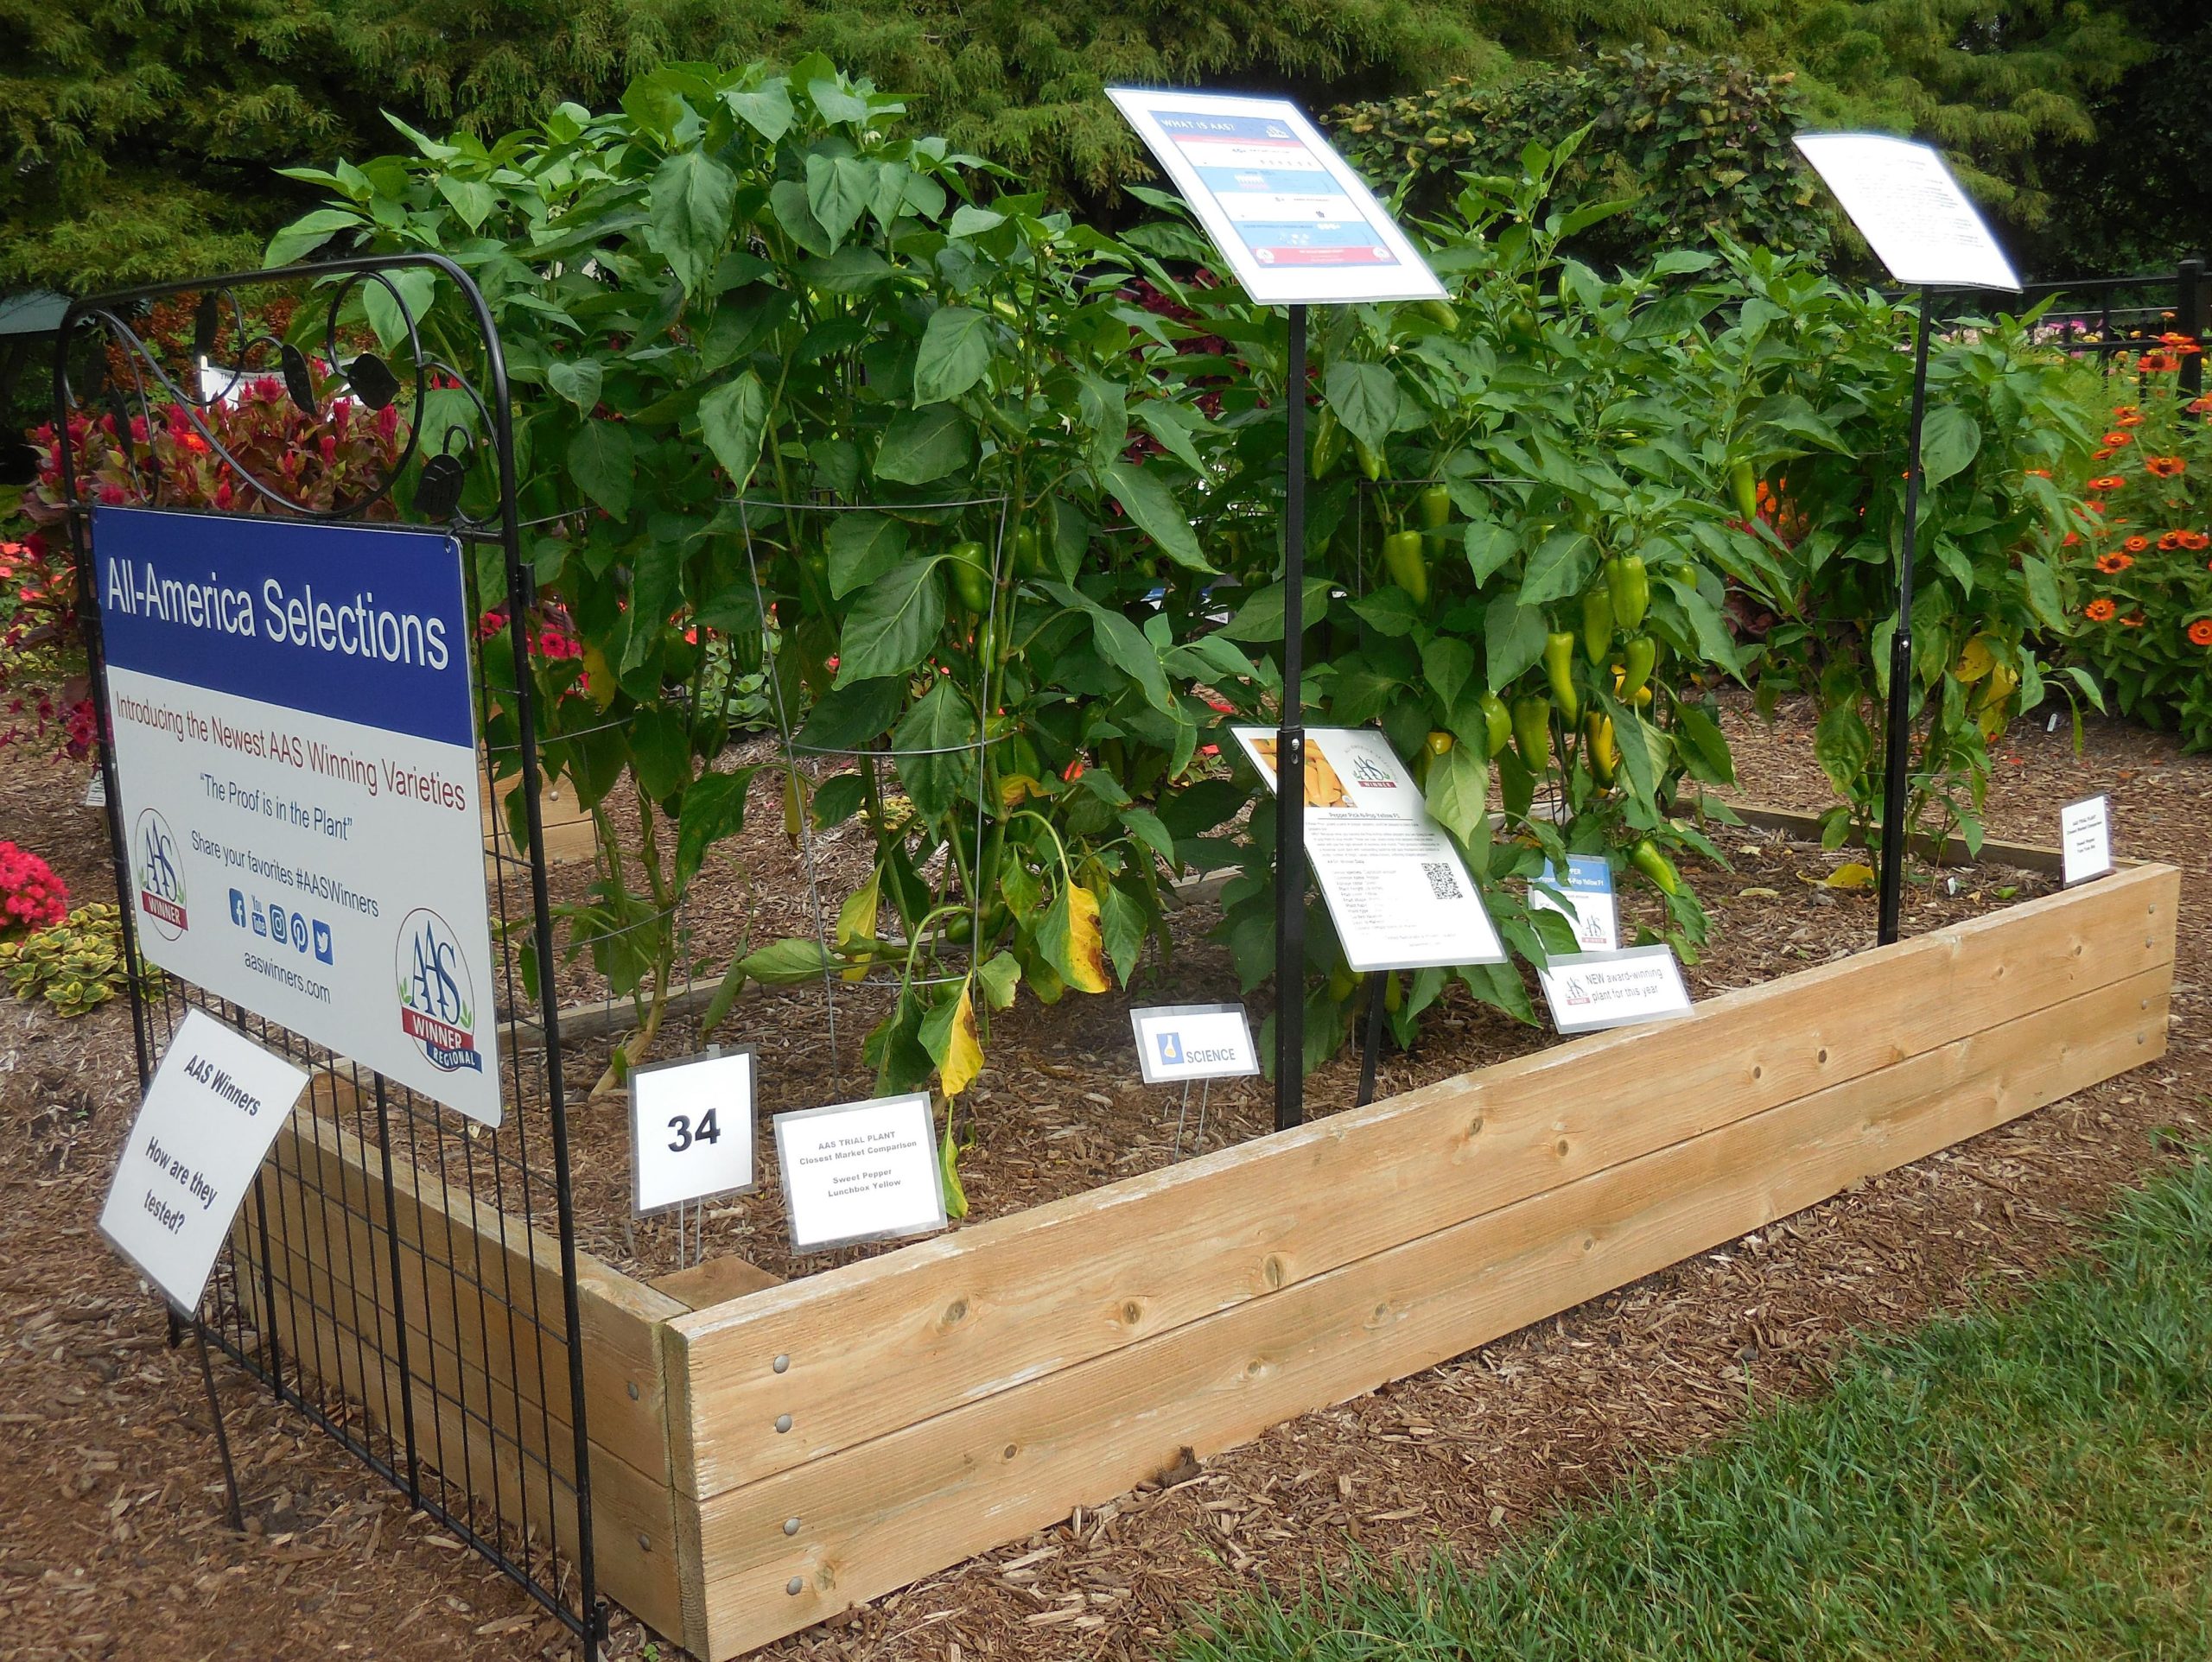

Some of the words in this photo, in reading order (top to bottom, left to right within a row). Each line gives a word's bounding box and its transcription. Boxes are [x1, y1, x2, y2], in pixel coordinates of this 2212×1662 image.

[1160, 119, 1194, 130] WHAT
[1211, 123, 1236, 131] AAS?
[108, 556, 257, 637] All-America
[264, 578, 449, 671] Selections
[116, 690, 184, 741] Introducing
[187, 711, 209, 742] the
[212, 718, 266, 758] Newest
[270, 731, 303, 769] AAS
[307, 739, 378, 796] Winning
[382, 758, 466, 811] Varieties
[229, 781, 260, 812] Proof
[263, 792, 273, 815] is
[276, 796, 288, 821] in
[290, 800, 311, 829] the
[145, 818, 178, 902] AAS
[192, 829, 221, 860] Share
[224, 847, 245, 869] your
[247, 849, 294, 887] favorites
[296, 867, 379, 917] #AASWinners
[148, 895, 181, 926] WINNER
[251, 894, 264, 913] You
[244, 951, 332, 1005] aaswinners.com
[408, 919, 461, 1026] AAS
[1586, 972, 1605, 986] NEW
[1606, 968, 1664, 984] award-winning
[1592, 990, 1612, 1004] plant
[1612, 988, 1624, 999] for
[1624, 987, 1641, 998] this
[1643, 985, 1659, 997] year
[412, 1014, 462, 1049] WINNER
[432, 1046, 476, 1068] REGIONAL
[1185, 1049, 1236, 1063] SCIENCE
[183, 1054, 214, 1085] AAS
[210, 1068, 262, 1117] Winners
[667, 1107, 721, 1153] 34
[817, 1139, 837, 1151] AAS
[838, 1136, 865, 1147] TRIAL
[867, 1131, 895, 1143] PLANT
[799, 1153, 833, 1165] Closest
[835, 1149, 865, 1161] Market
[868, 1139, 917, 1155] Comparison
[145, 1135, 172, 1170] How
[170, 1159, 190, 1186] are
[189, 1170, 219, 1211] they
[828, 1183, 870, 1197] Lunchbox
[872, 1177, 901, 1189] Yellow
[832, 1173, 861, 1184] Sweet
[862, 1168, 892, 1181] Pepper
[143, 1189, 186, 1236] tested?
